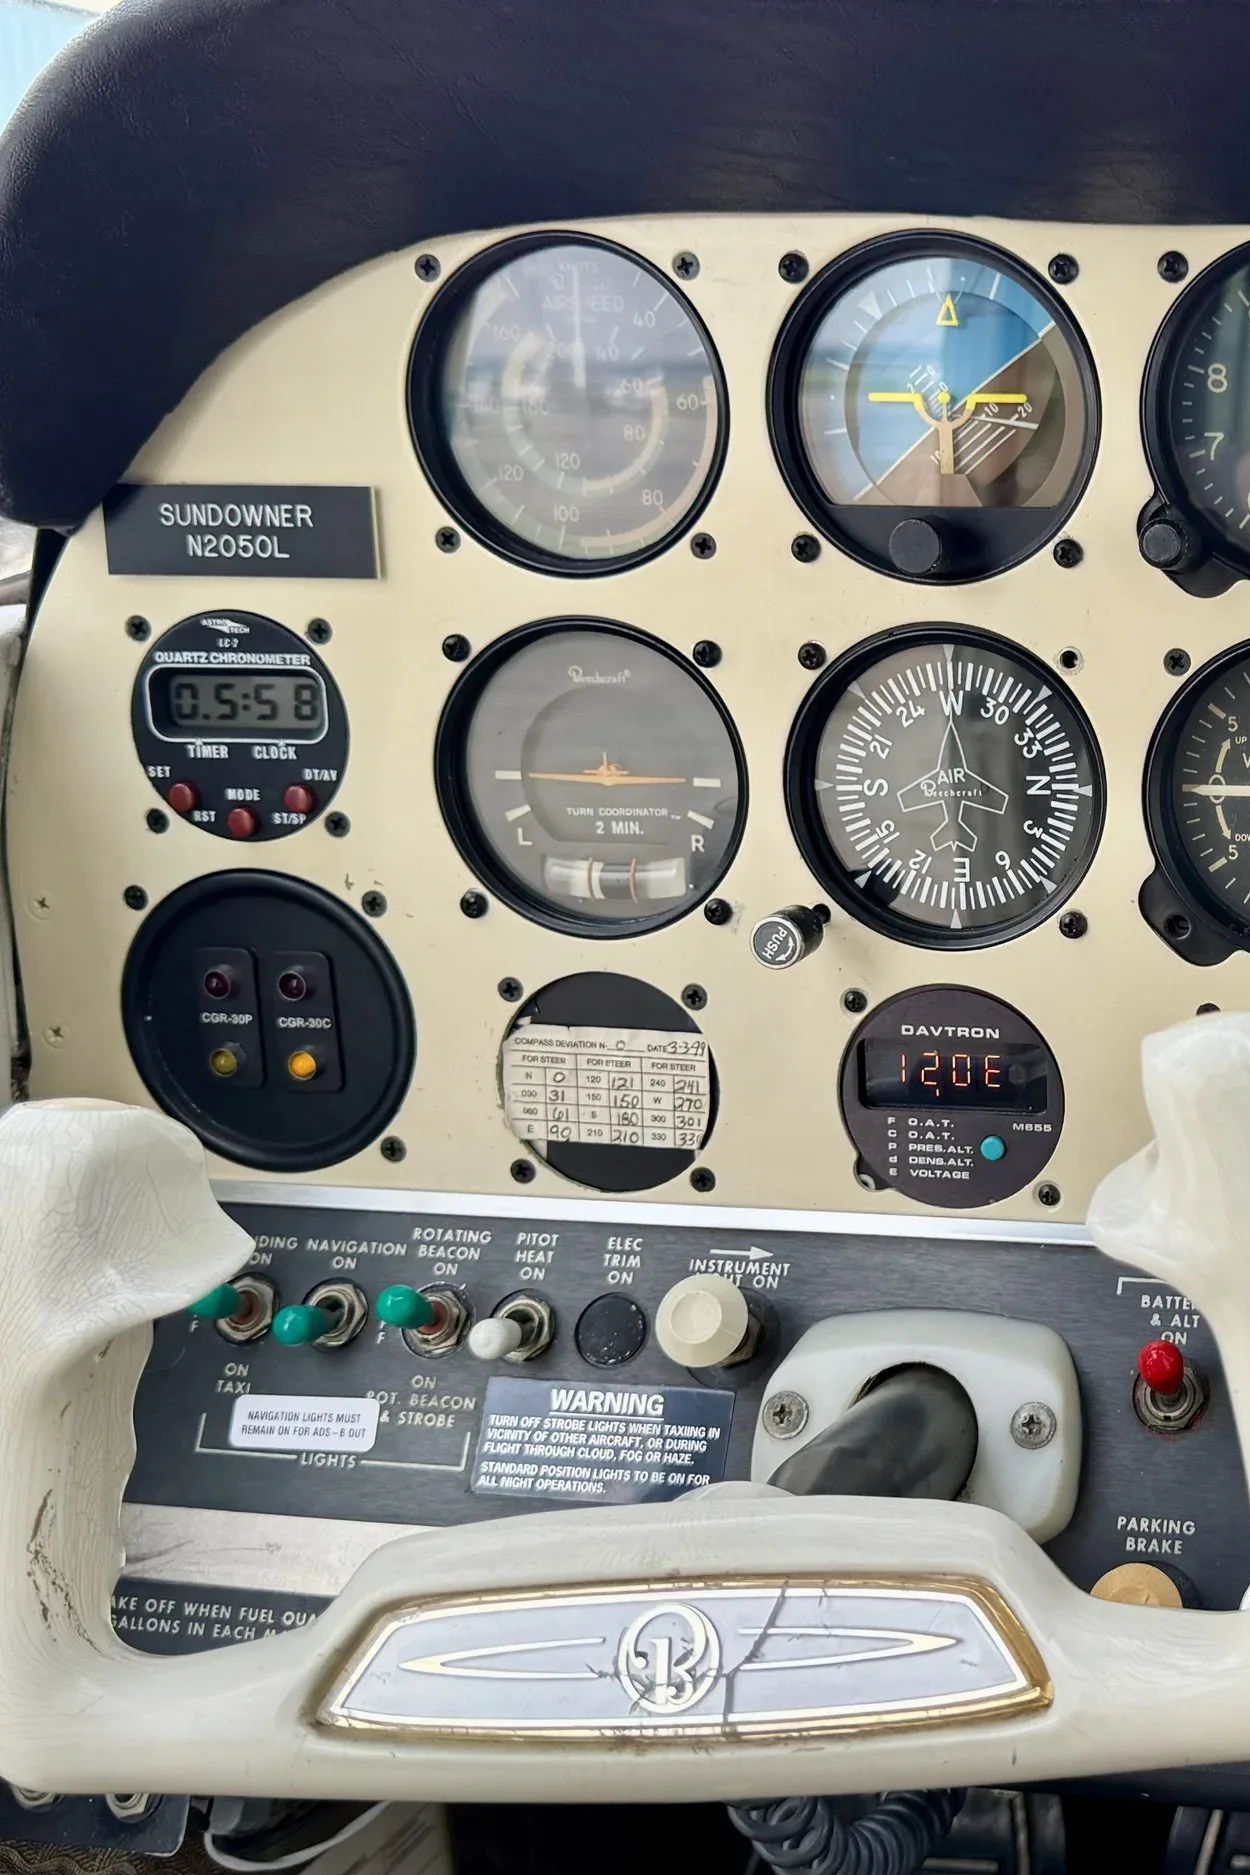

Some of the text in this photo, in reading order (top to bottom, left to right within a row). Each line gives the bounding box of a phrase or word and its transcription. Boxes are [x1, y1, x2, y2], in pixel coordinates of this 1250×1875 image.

[633, 310, 655, 327] 40
[1207, 364, 1227, 393] 8
[676, 395, 698, 410] 60
[1204, 433, 1224, 460] 7
[642, 490, 663, 505] 80
[160, 504, 314, 527] SUNDOWNER
[554, 506, 579, 521] 100
[187, 534, 290, 558] N2050L
[156, 652, 310, 665] QUARTZ CHRONOMETER
[980, 697, 1009, 725] 30
[1236, 736, 1247, 744] UP
[187, 745, 229, 758] TIMER
[253, 746, 297, 760] CLOCK
[149, 766, 171, 777] SET
[937, 768, 966, 784] AIR
[1026, 776, 1051, 794] N
[225, 789, 260, 800] MODE
[194, 811, 216, 822] RST
[567, 807, 667, 816] TURN COORDINATOR
[596, 822, 644, 835] 2 MIN.
[518, 828, 532, 845] L
[691, 835, 704, 852] R
[202, 1012, 252, 1024] CGR-30P
[277, 1017, 331, 1028] CGR-30C
[901, 1025, 1000, 1039] DAVTRON
[515, 1038, 597, 1048] COMPASS DEVIATION
[648, 1044, 667, 1052] DATE
[1013, 1123, 1052, 1132] M655
[910, 1169, 969, 1179] VOLTAGE
[412, 1228, 492, 1243] ROTATING
[517, 1232, 559, 1247] PITOT
[308, 1239, 407, 1256] NAVIGATION
[608, 1237, 643, 1250] ELEC
[419, 1244, 480, 1260] BEACON
[516, 1250, 554, 1264] HEAT
[332, 1257, 357, 1269] ON
[603, 1254, 641, 1268] TRIM
[689, 1259, 790, 1276] INSTRUMENT
[433, 1262, 458, 1276] ON
[520, 1268, 545, 1281] ON
[607, 1271, 634, 1284] ON
[550, 1389, 664, 1415] WARNING
[248, 1411, 360, 1423] NAVIGATION LIGHTS MUST
[300, 1454, 357, 1468] LIGHTS
[1117, 1516, 1196, 1535] PARKING
[1126, 1537, 1182, 1554] BRAKE
